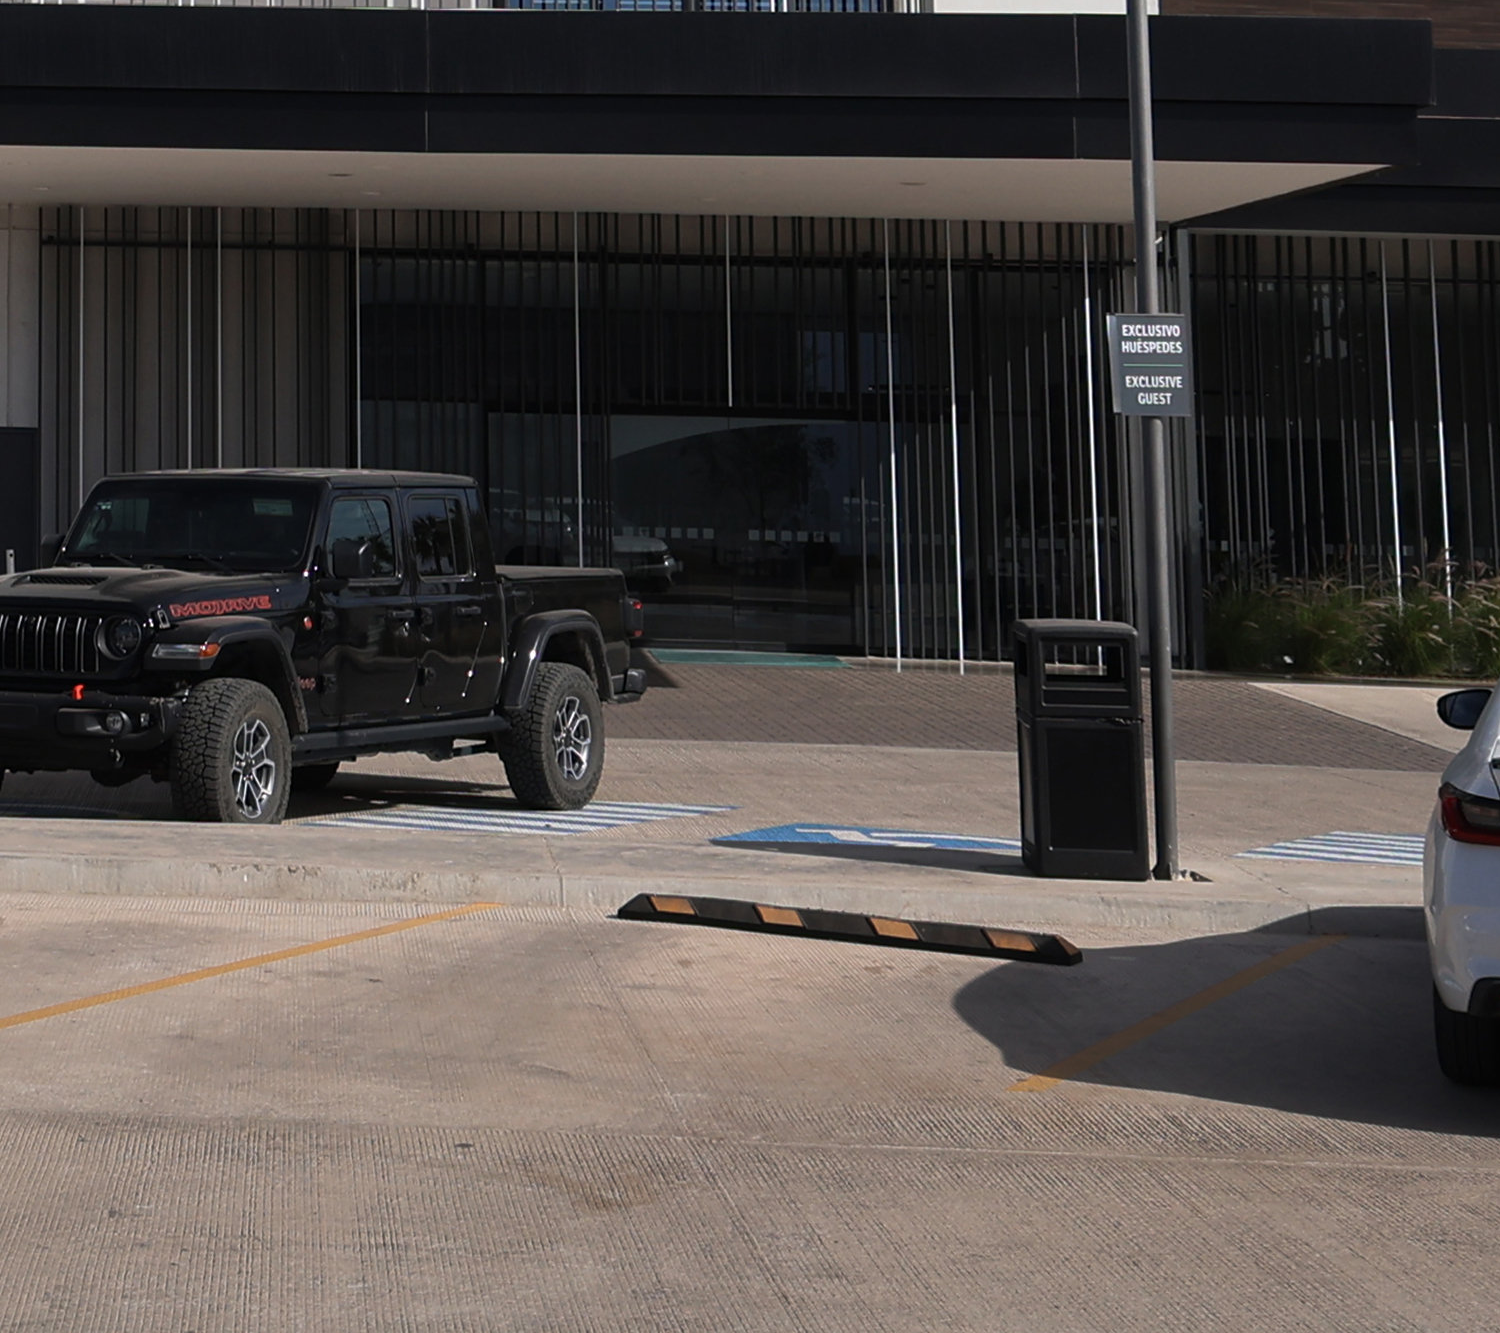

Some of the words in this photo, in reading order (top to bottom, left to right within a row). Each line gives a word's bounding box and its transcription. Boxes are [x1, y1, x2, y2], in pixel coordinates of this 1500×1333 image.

[1121, 324, 1181, 337] EXCLUSIVO
[1121, 338, 1183, 353] HUÉSPEDES
[1125, 375, 1183, 388] EXCLUSIVE
[1137, 392, 1172, 405] GUEST
[169, 595, 272, 617] MOJAVE
